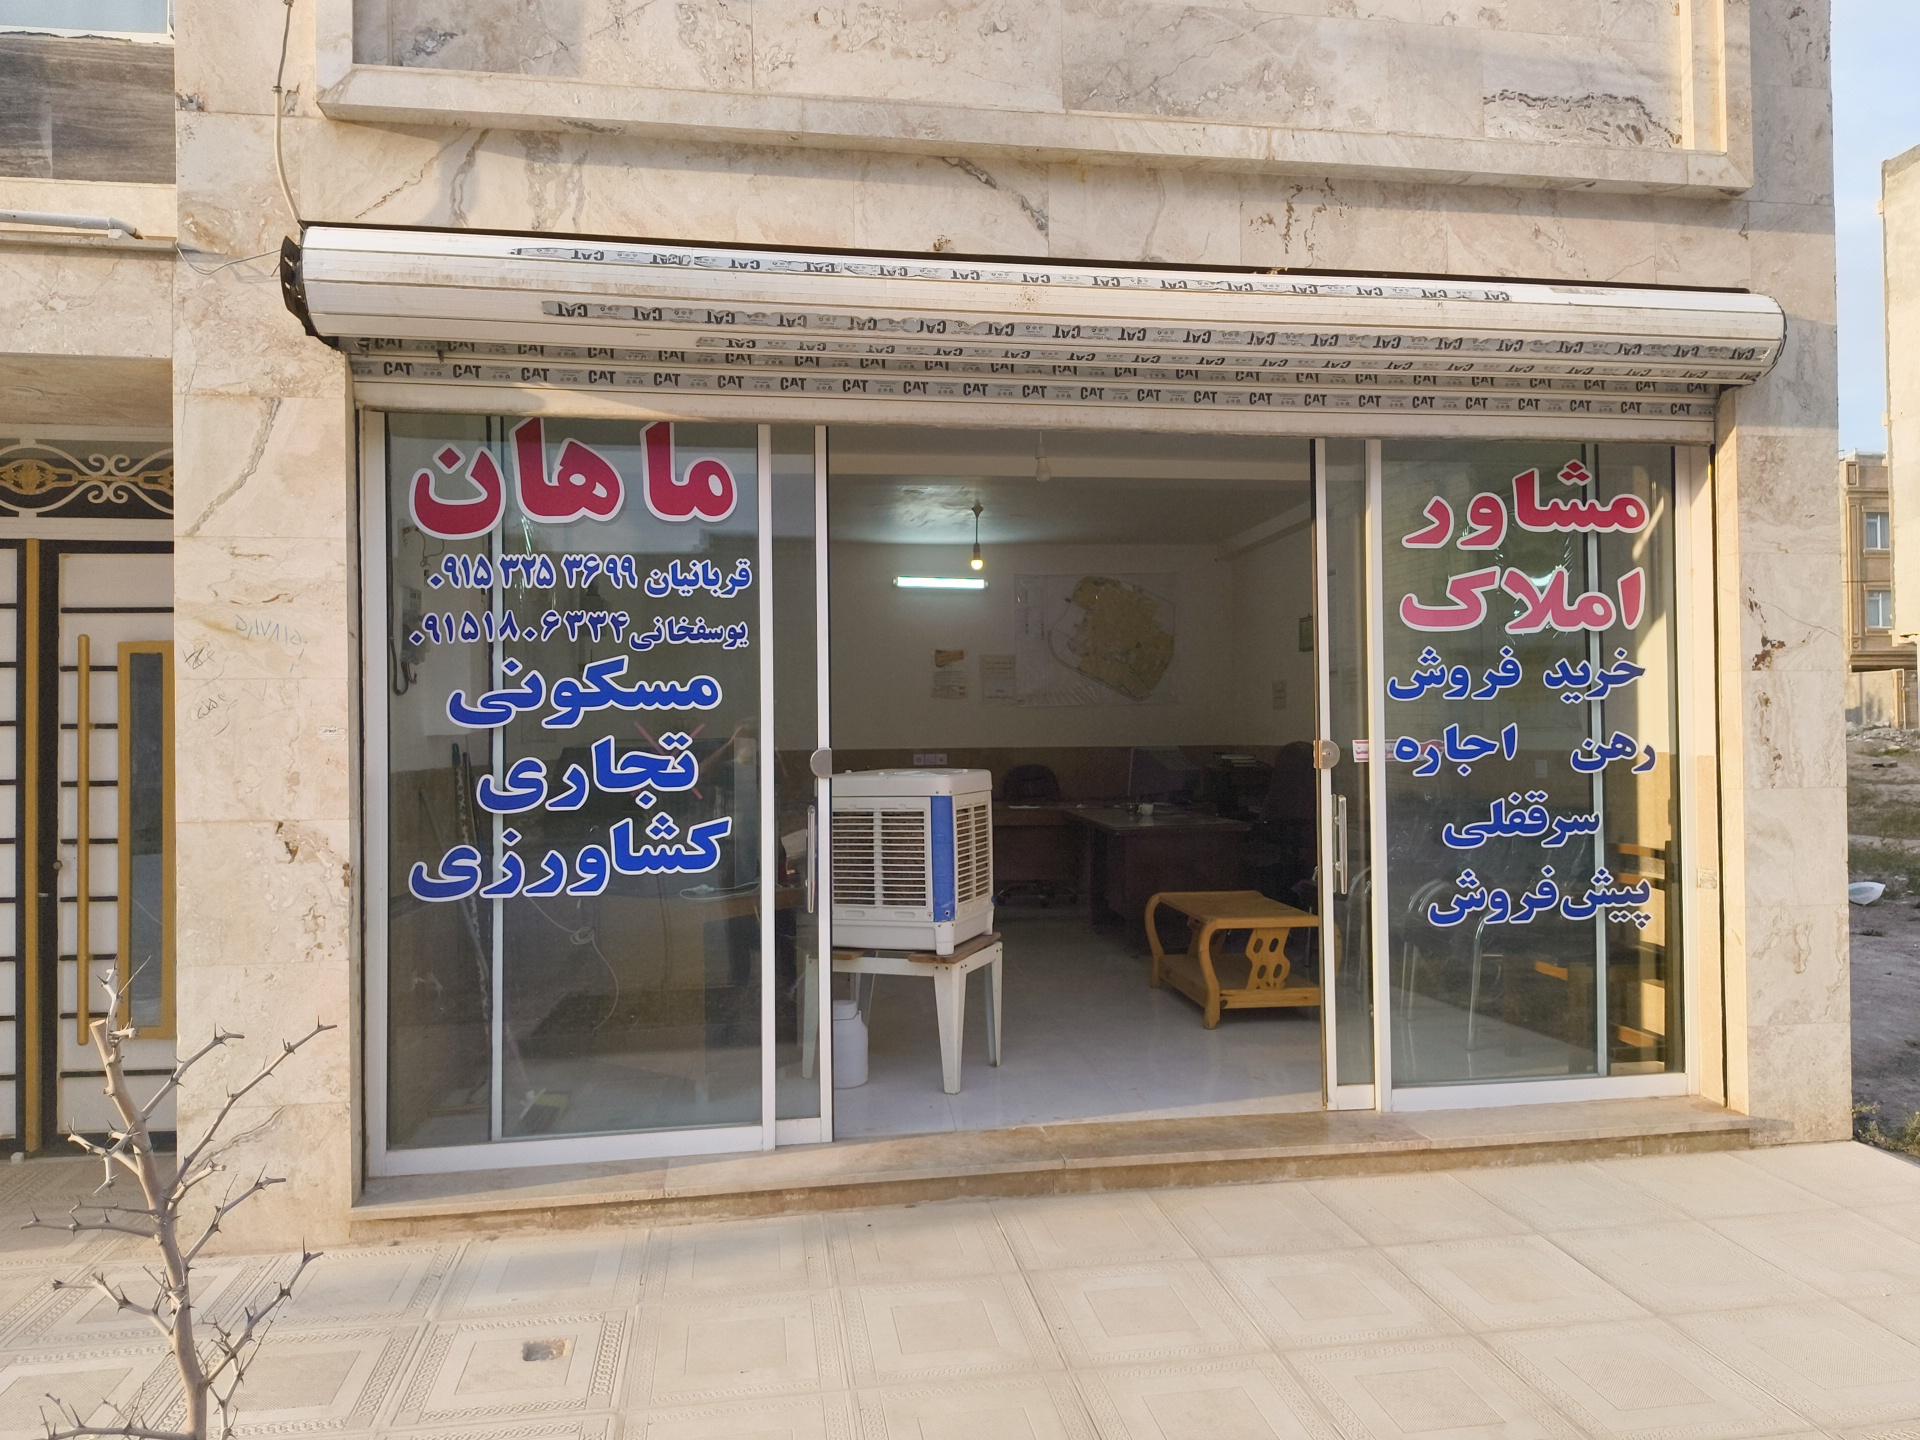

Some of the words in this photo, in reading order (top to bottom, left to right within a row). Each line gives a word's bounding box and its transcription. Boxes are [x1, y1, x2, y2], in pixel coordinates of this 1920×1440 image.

[556, 304, 587, 317] CAT
[632, 308, 662, 321] CAT
[705, 311, 735, 324] CAT
[777, 314, 807, 327] CAT
[847, 318, 877, 330] CAT
[917, 320, 946, 333] CAT
[985, 323, 1014, 336] CAT
[1052, 325, 1081, 339] CAT
[1118, 328, 1146, 341] CAT
[1183, 330, 1211, 343] CAT
[1247, 332, 1275, 345] CAT
[1311, 334, 1338, 346] CAT
[1373, 336, 1401, 349] CAT
[1435, 338, 1463, 350] CAT
[1496, 339, 1523, 352] CAT
[1557, 342, 1584, 353] CAT
[1617, 344, 1642, 355] CAT
[1673, 346, 1699, 357] CAT
[1729, 349, 1755, 360] CAT
[726, 339, 756, 348] CAT
[797, 342, 826, 351] CAT
[866, 345, 895, 354] CAT
[934, 348, 963, 357] CAT
[1001, 350, 1030, 359] CAT
[1067, 352, 1096, 361] CAT
[1131, 354, 1160, 364] CAT
[1196, 357, 1225, 366] CAT
[1259, 359, 1288, 367] CAT
[1321, 360, 1351, 369] CAT
[1384, 361, 1412, 370] CAT
[1446, 363, 1474, 371] CAT
[1505, 365, 1535, 373] CAT
[1566, 367, 1594, 375] CAT
[1680, 370, 1708, 378] CAT
[384, 362, 413, 376] CAT
[453, 365, 481, 378] CAT
[521, 368, 549, 381] CAT
[588, 371, 616, 383] CAT
[654, 373, 680, 386] CAT
[717, 375, 744, 389] CAT
[780, 377, 806, 390] CAT
[842, 379, 869, 392] CAT
[903, 381, 928, 394] CAT
[963, 383, 989, 396] CAT
[1022, 385, 1047, 398] CAT
[1080, 387, 1105, 400] CAT
[1137, 389, 1161, 401] CAT
[1194, 391, 1217, 403] CAT
[1249, 393, 1272, 405] CAT
[1304, 394, 1327, 406] CAT
[1358, 395, 1381, 407] CAT
[1412, 396, 1435, 408] CAT
[1466, 397, 1488, 409] CAT
[1518, 399, 1540, 411] CAT
[1570, 400, 1591, 412] CAT
[1620, 401, 1642, 414] CAT
[1670, 403, 1692, 415] CAT
[1403, 460, 1647, 549] مشاور
[646, 560, 750, 596] قربانیان
[1401, 568, 1644, 632] املاک
[448, 657, 720, 727] مسکونی
[1388, 647, 1521, 700] فروش
[1544, 648, 1645, 702] خرید
[478, 733, 696, 812] تجاری
[1394, 723, 1517, 775] اجاره
[1571, 729, 1656, 772] رهن
[1443, 792, 1599, 848] سرقفلی
[410, 813, 730, 899] کشاورزی
